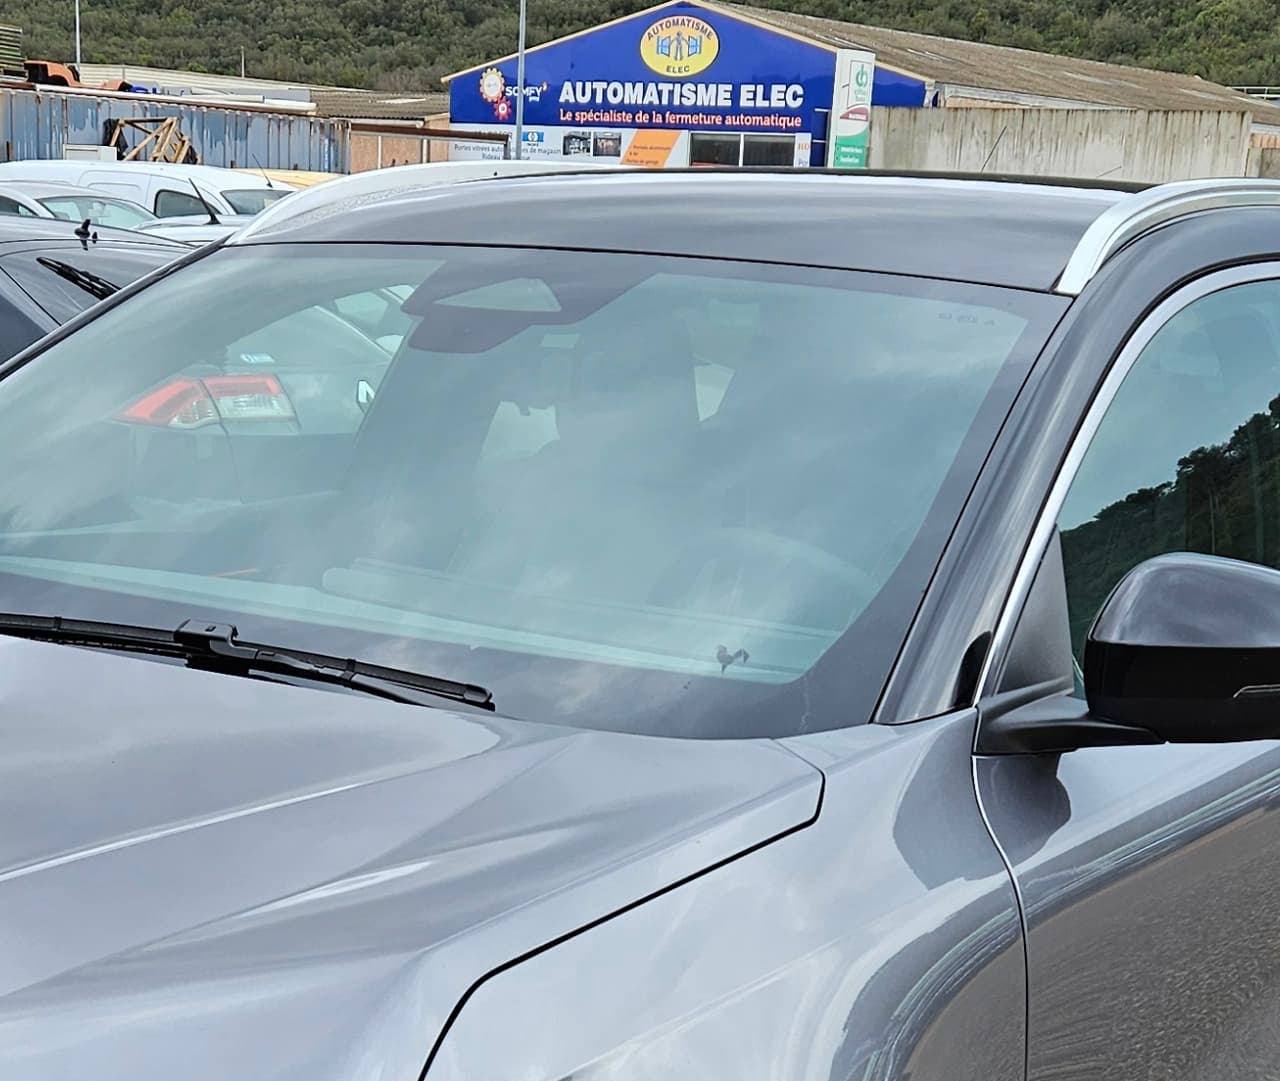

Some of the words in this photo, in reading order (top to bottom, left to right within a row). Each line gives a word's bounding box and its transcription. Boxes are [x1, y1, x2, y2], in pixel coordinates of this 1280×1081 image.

[647, 17, 713, 41] AUTOMATISME
[666, 65, 690, 73] ELEC
[559, 81, 733, 107] AUTOMATISME
[739, 84, 804, 108] ELEC
[560, 108, 573, 121] Le
[575, 108, 633, 125] spécialiste
[635, 110, 650, 124] de
[652, 110, 663, 124] la
[665, 110, 723, 126] fermeture
[725, 114, 802, 129] automatique
